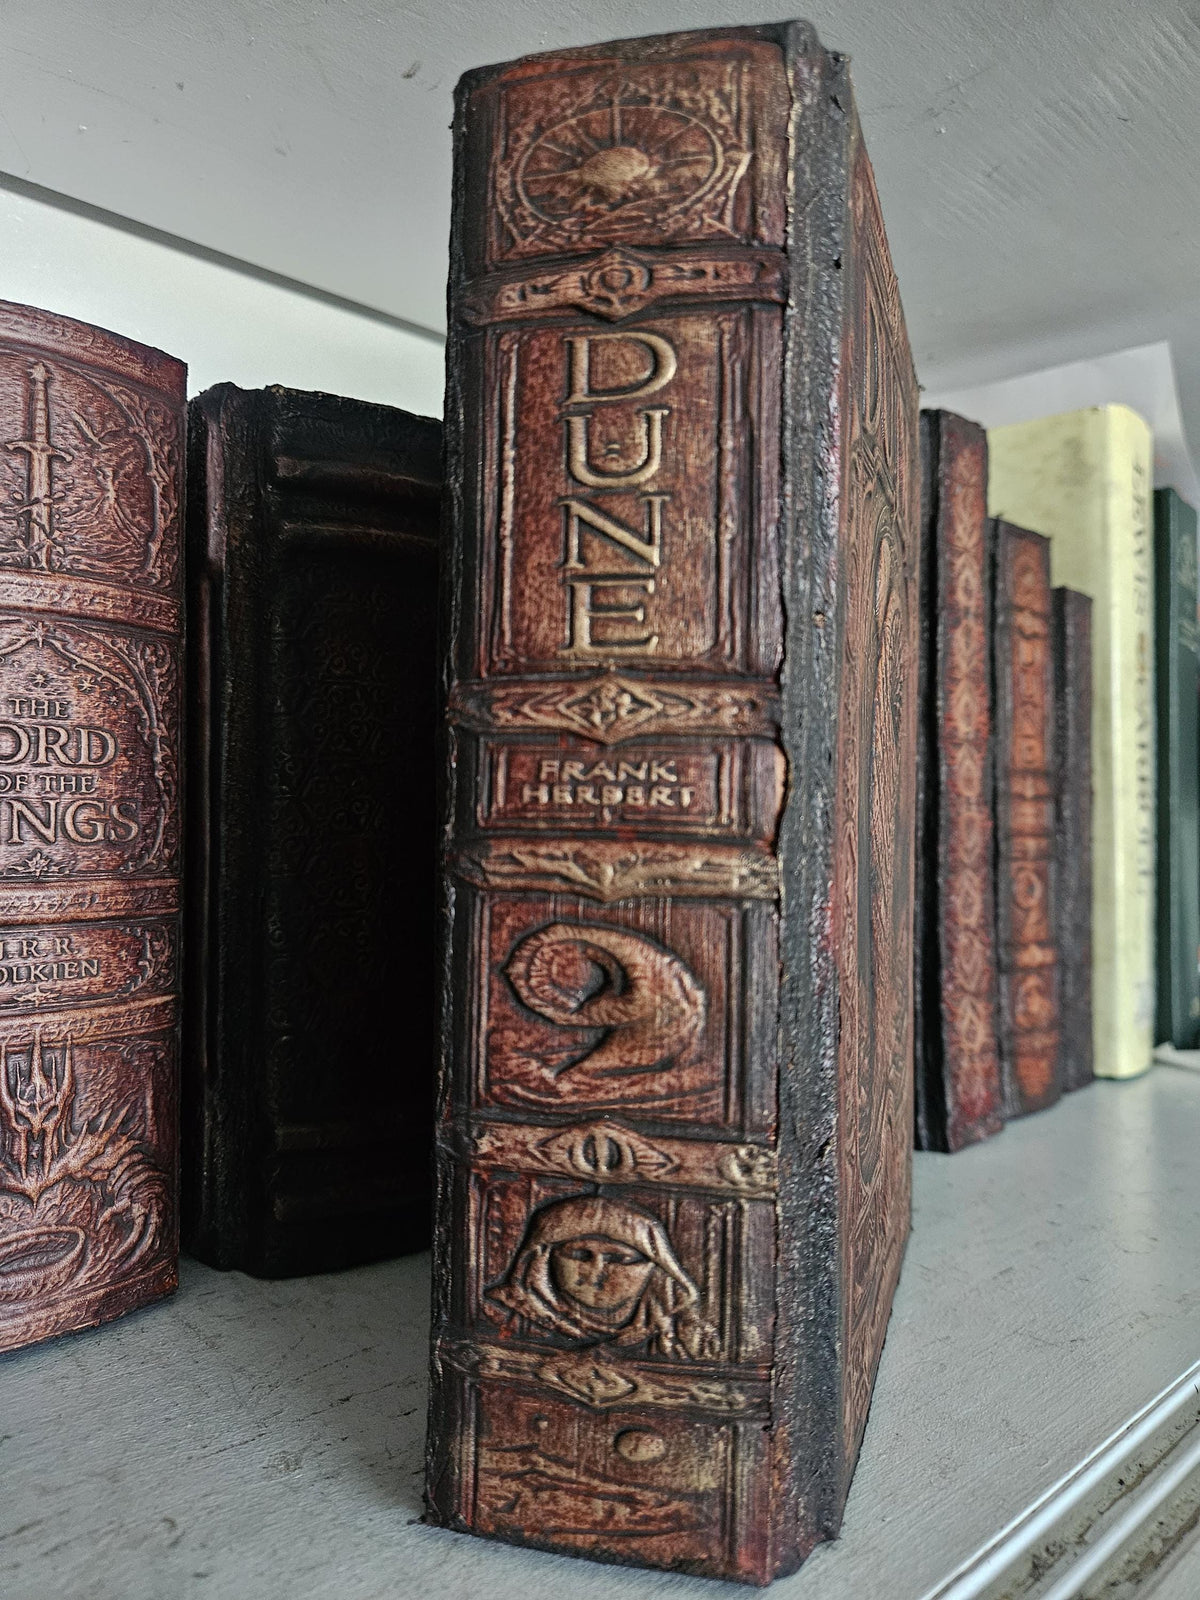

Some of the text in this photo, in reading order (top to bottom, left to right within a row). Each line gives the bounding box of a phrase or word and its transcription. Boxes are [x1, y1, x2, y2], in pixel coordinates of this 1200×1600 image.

[557, 331, 678, 657] DUNE
[8, 698, 69, 718] THE
[539, 759, 678, 783] FRANK
[39, 775, 96, 793] THE
[522, 784, 696, 808] HERBERT
